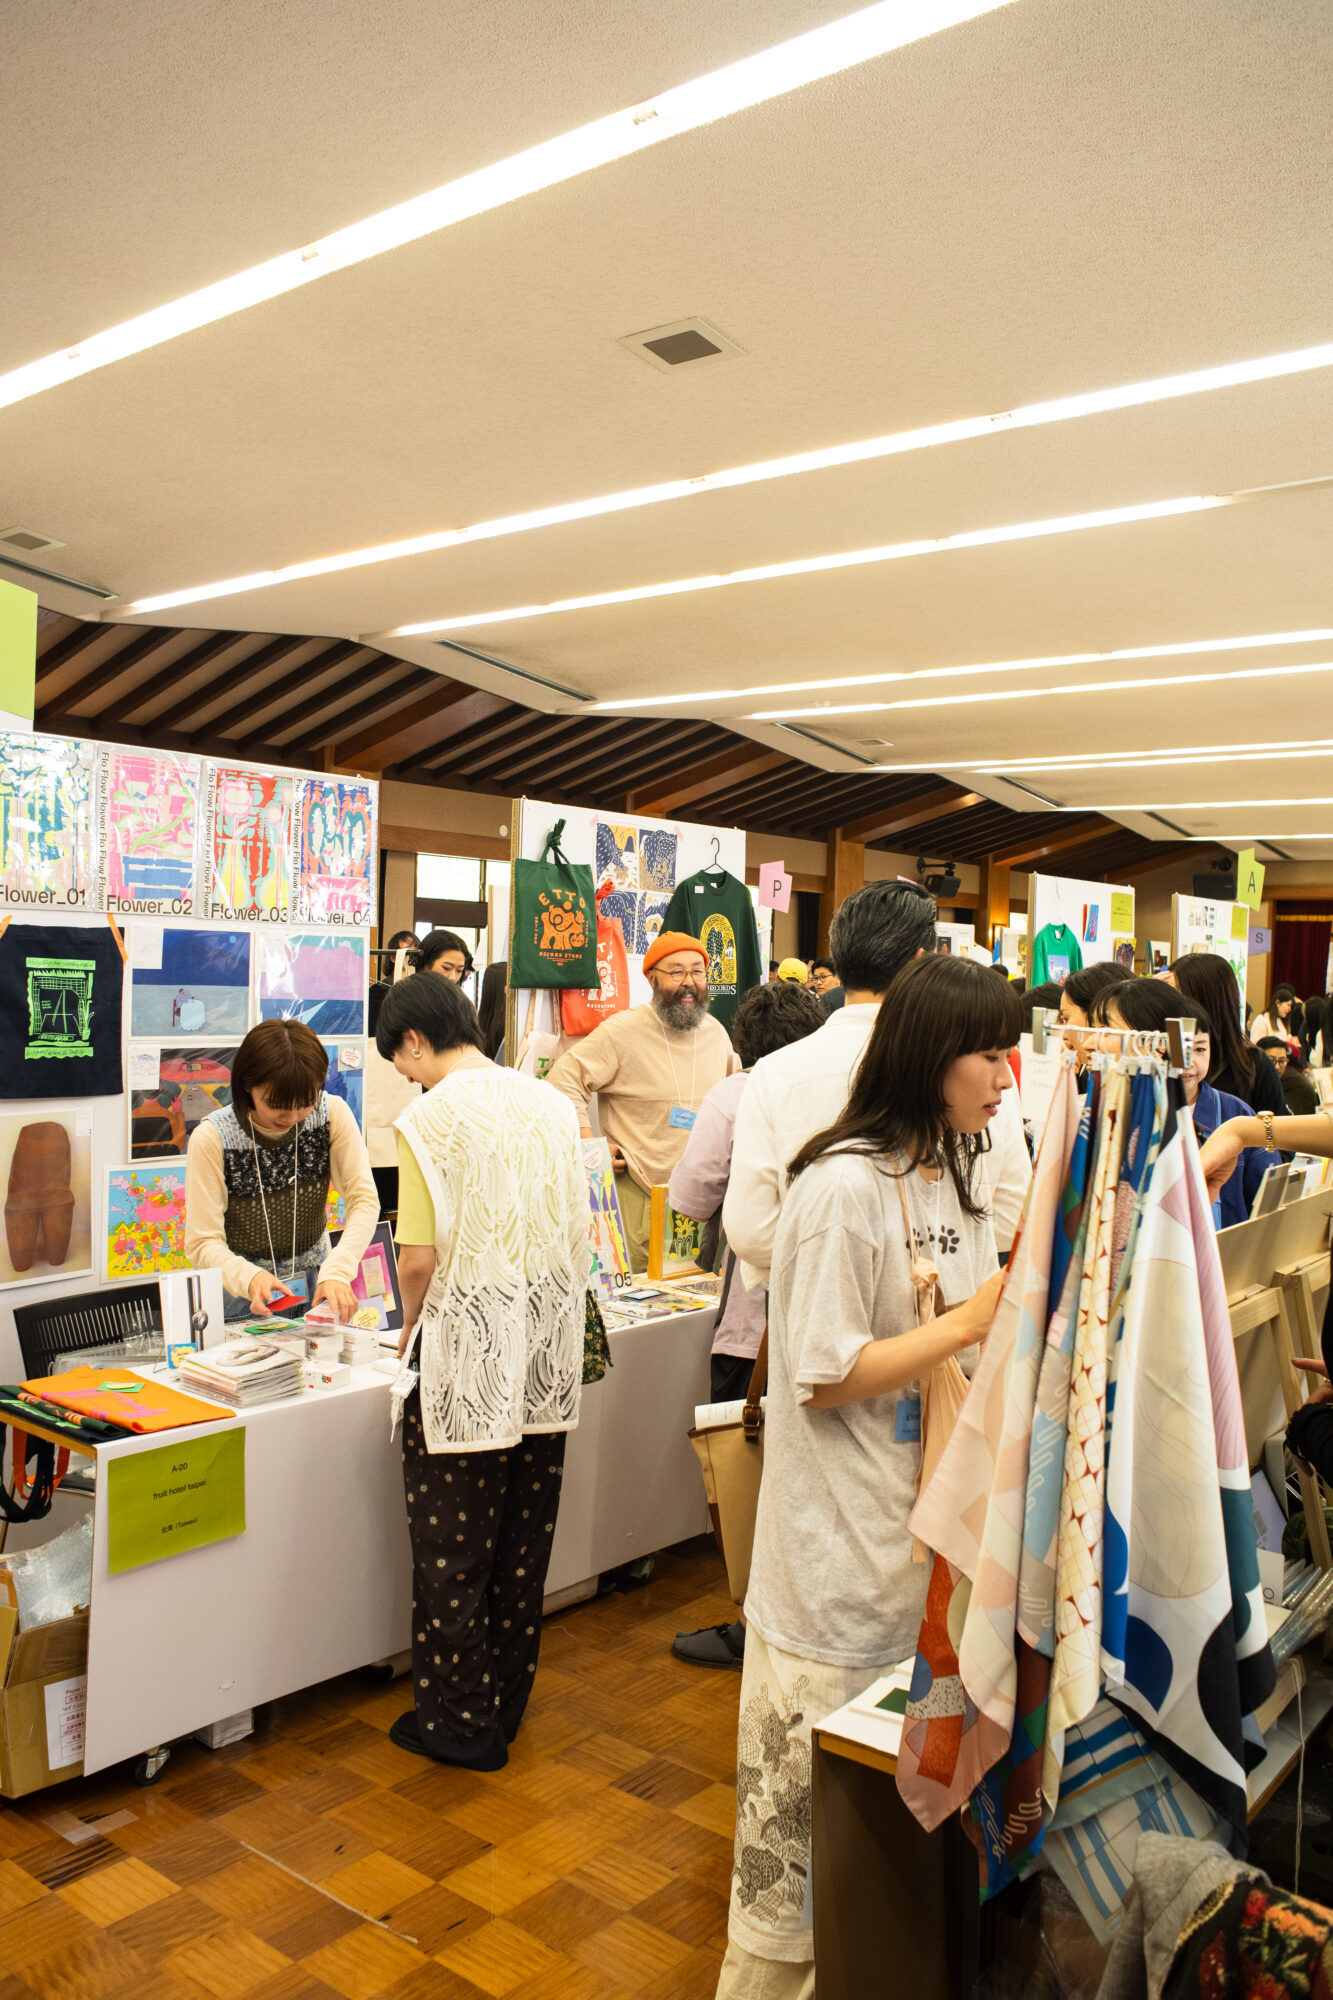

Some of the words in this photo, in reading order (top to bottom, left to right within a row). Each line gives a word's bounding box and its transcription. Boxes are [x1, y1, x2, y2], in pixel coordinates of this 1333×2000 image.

[772, 879, 783, 899] P
[1247, 871, 1256, 893] A
[106, 894, 192, 915] Flower_02
[211, 902, 288, 923] Flower_03
[1255, 932, 1264, 945] S
[171, 1462, 188, 1473] A-20
[152, 1491, 168, 1500] fruit
[168, 1484, 187, 1495] hotel
[187, 1480, 207, 1490] taipei
